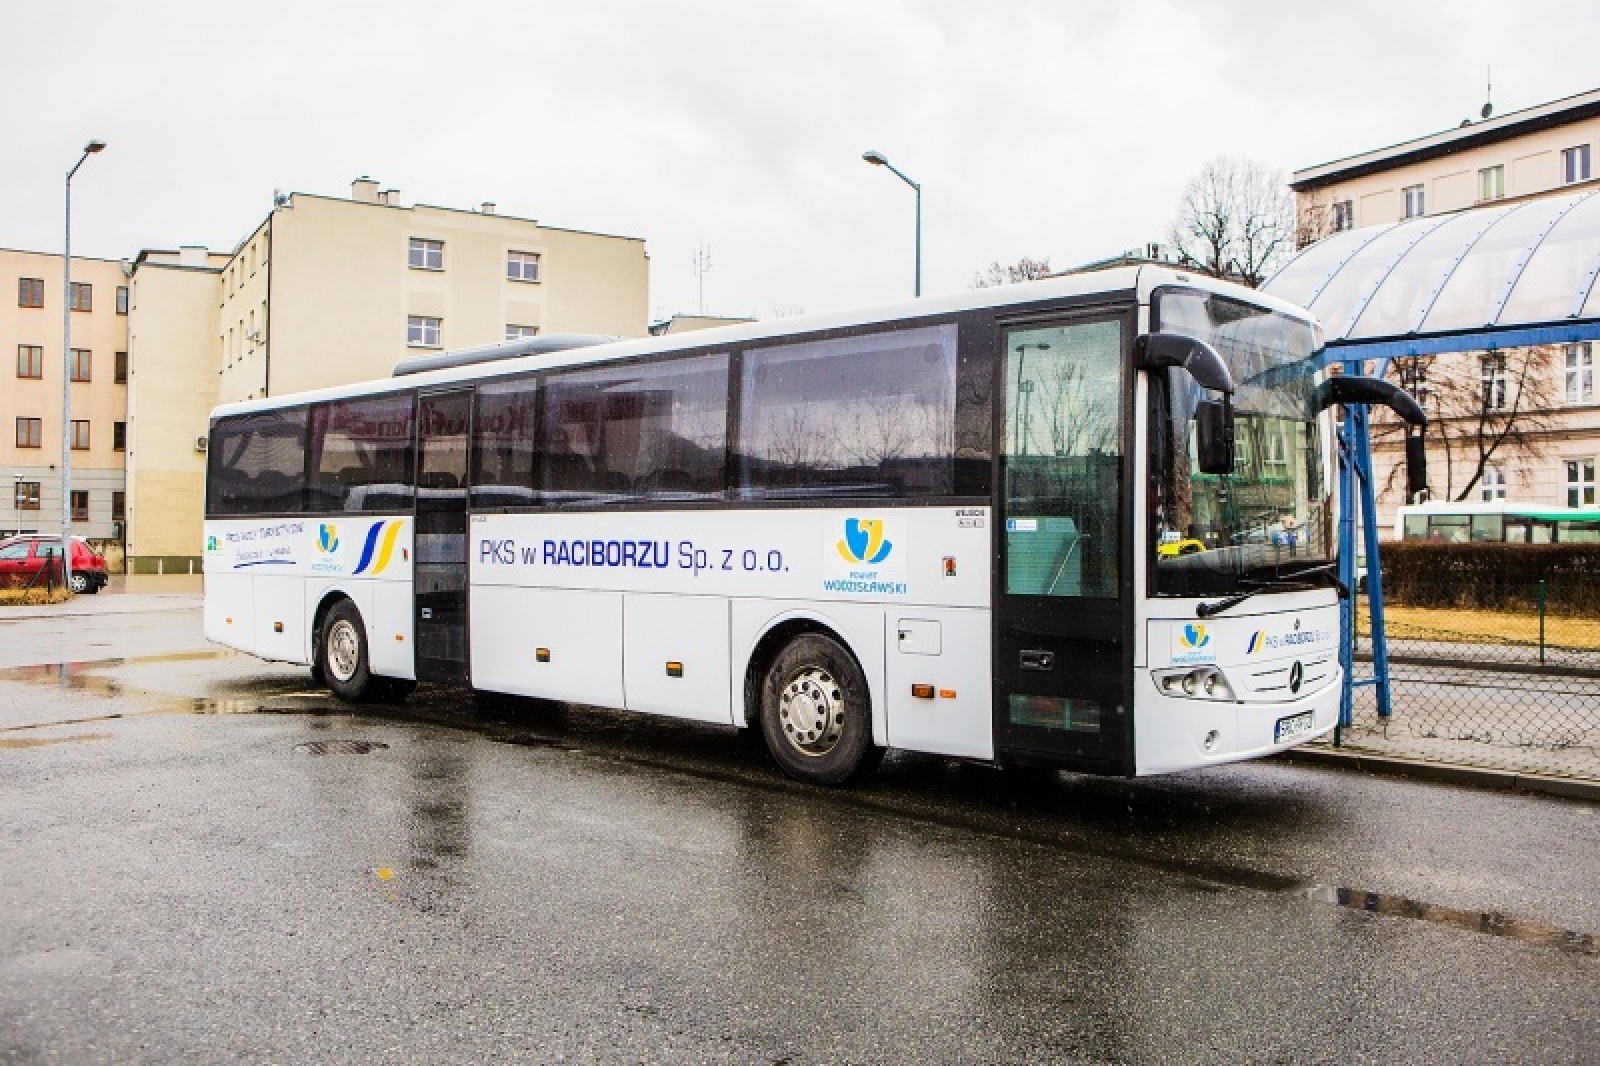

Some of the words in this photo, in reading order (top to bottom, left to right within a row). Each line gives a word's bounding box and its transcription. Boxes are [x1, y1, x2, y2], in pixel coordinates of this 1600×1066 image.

[479, 540, 515, 565] PKS
[521, 547, 537, 565] w
[543, 540, 669, 568] RACIBORZU
[678, 541, 714, 577] Sp.
[721, 550, 733, 571] z
[742, 550, 789, 573] o.o.
[824, 579, 907, 595] WODZISŁAWSKI
